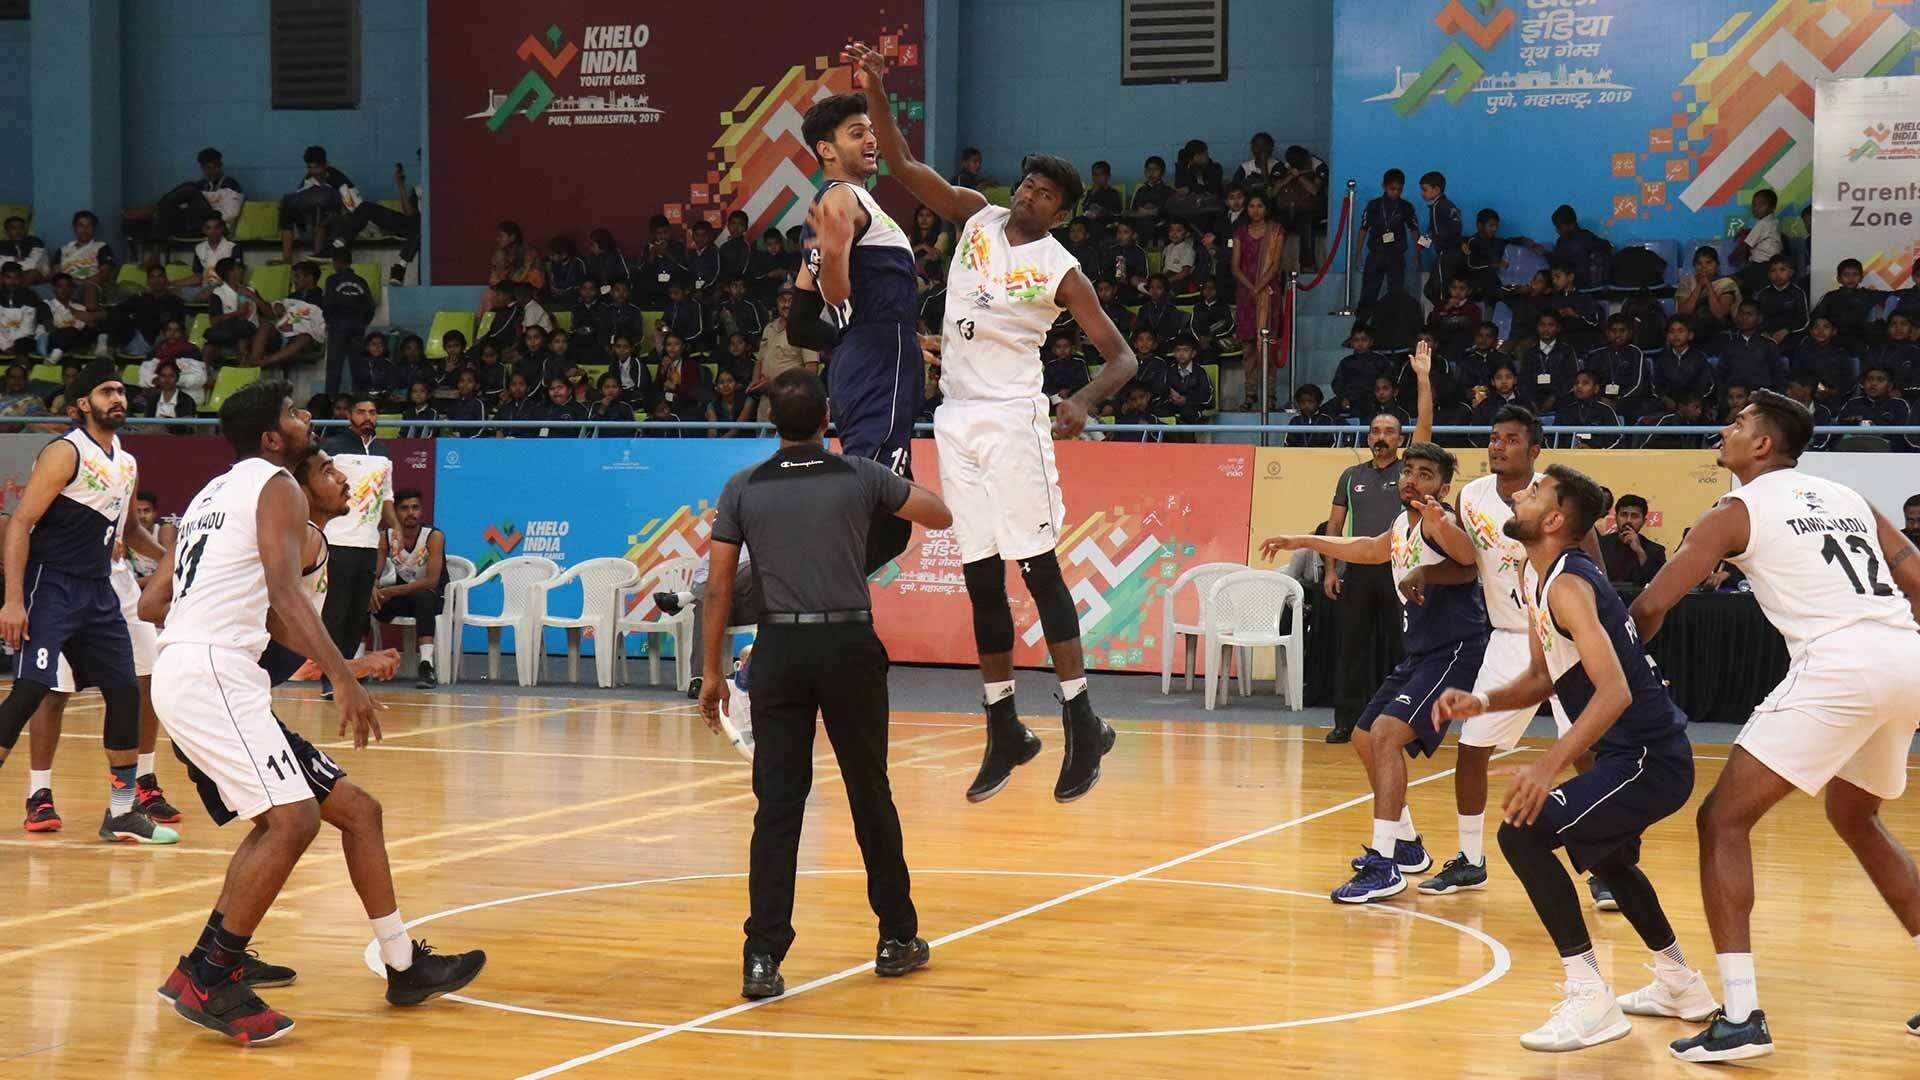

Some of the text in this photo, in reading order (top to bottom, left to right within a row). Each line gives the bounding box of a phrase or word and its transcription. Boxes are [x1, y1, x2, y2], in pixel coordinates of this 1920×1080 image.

[1521, 8, 1614, 43] इंडिया
[584, 24, 650, 49] KHELO
[581, 49, 638, 74] INDIA
[1520, 45, 1552, 67] यूथ
[580, 74, 646, 87] YOUTH GAMES
[1597, 90, 1633, 104] 2019
[548, 112, 660, 127] PUNE, MAHARASHTRA, 2019
[1850, 207, 1913, 227] Zone
[780, 460, 824, 468] Champion
[526, 520, 570, 537] KHELO
[522, 536, 561, 552] INDIA
[1820, 533, 1895, 597] 12
[36, 647, 49, 670] 8
[266, 749, 298, 781] 11
